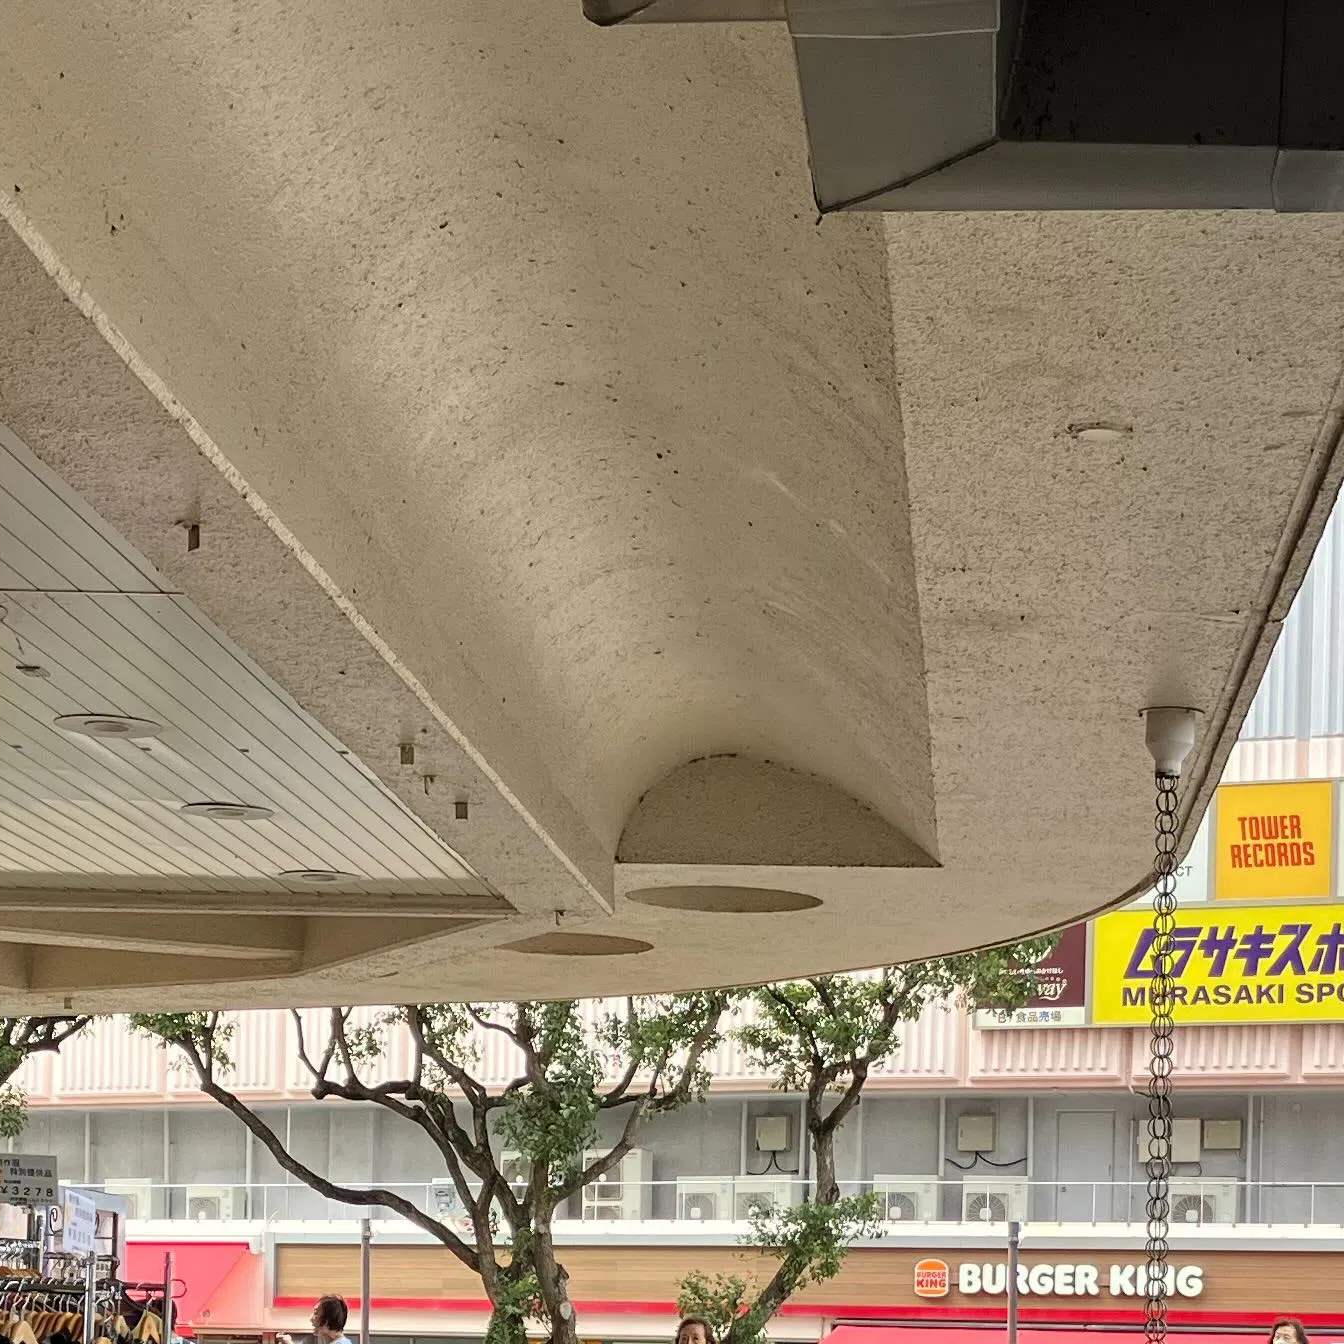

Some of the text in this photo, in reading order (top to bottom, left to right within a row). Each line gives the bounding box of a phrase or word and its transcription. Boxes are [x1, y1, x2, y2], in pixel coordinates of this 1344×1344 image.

[1237, 815, 1303, 842] TOWER
[1230, 841, 1316, 869] RECORDS
[916, 1278, 947, 1289] KING
[958, 1263, 1204, 1298] BURGER KING
